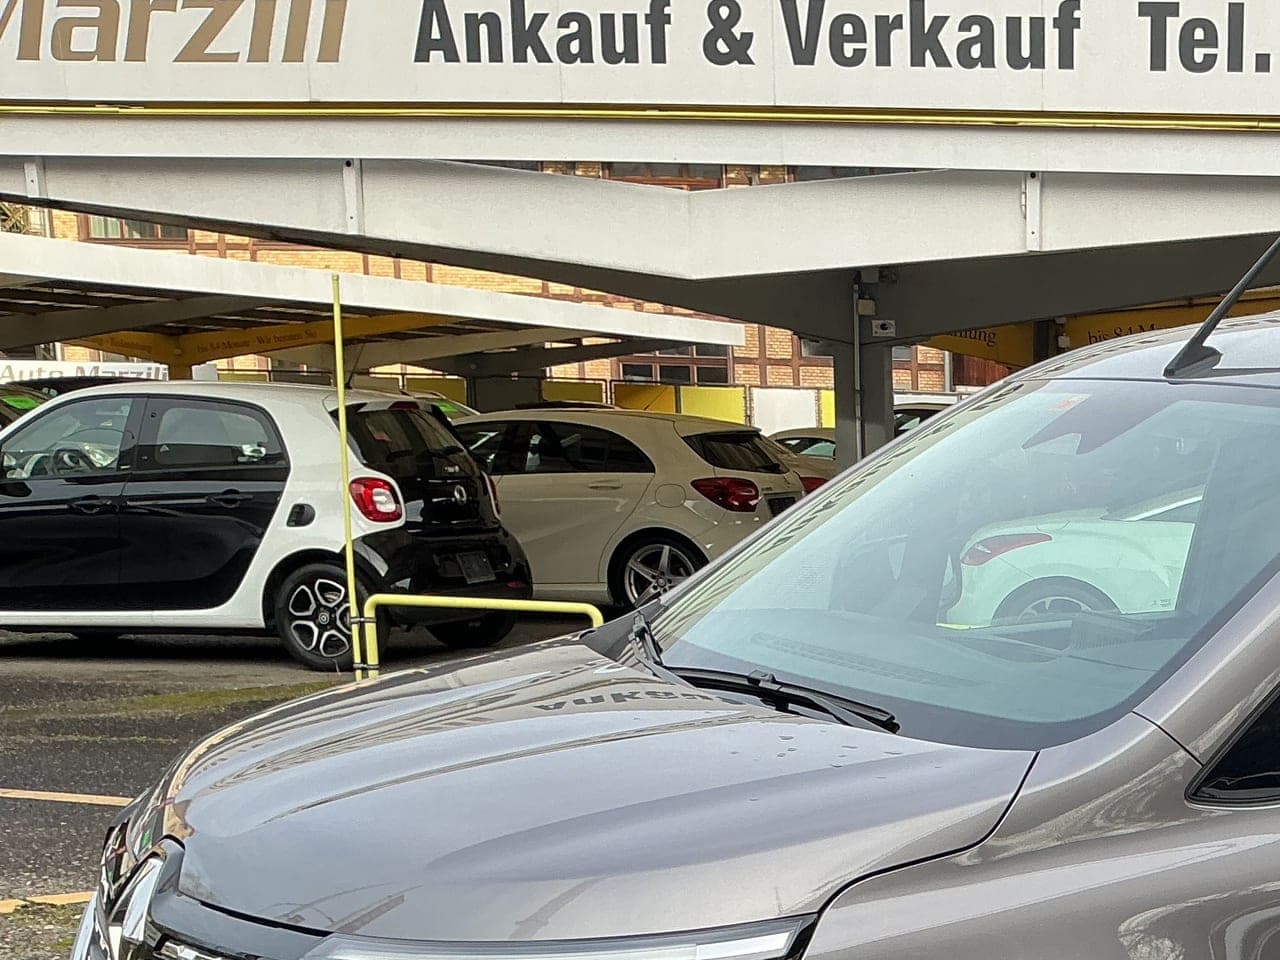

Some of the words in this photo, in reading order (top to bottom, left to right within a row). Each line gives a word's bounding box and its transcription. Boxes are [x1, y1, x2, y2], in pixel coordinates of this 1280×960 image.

[413, 0, 672, 65] Ankauf
[701, 0, 755, 67] &
[782, 0, 1083, 70] Verkauf
[1138, 1, 1271, 73] Tel.
